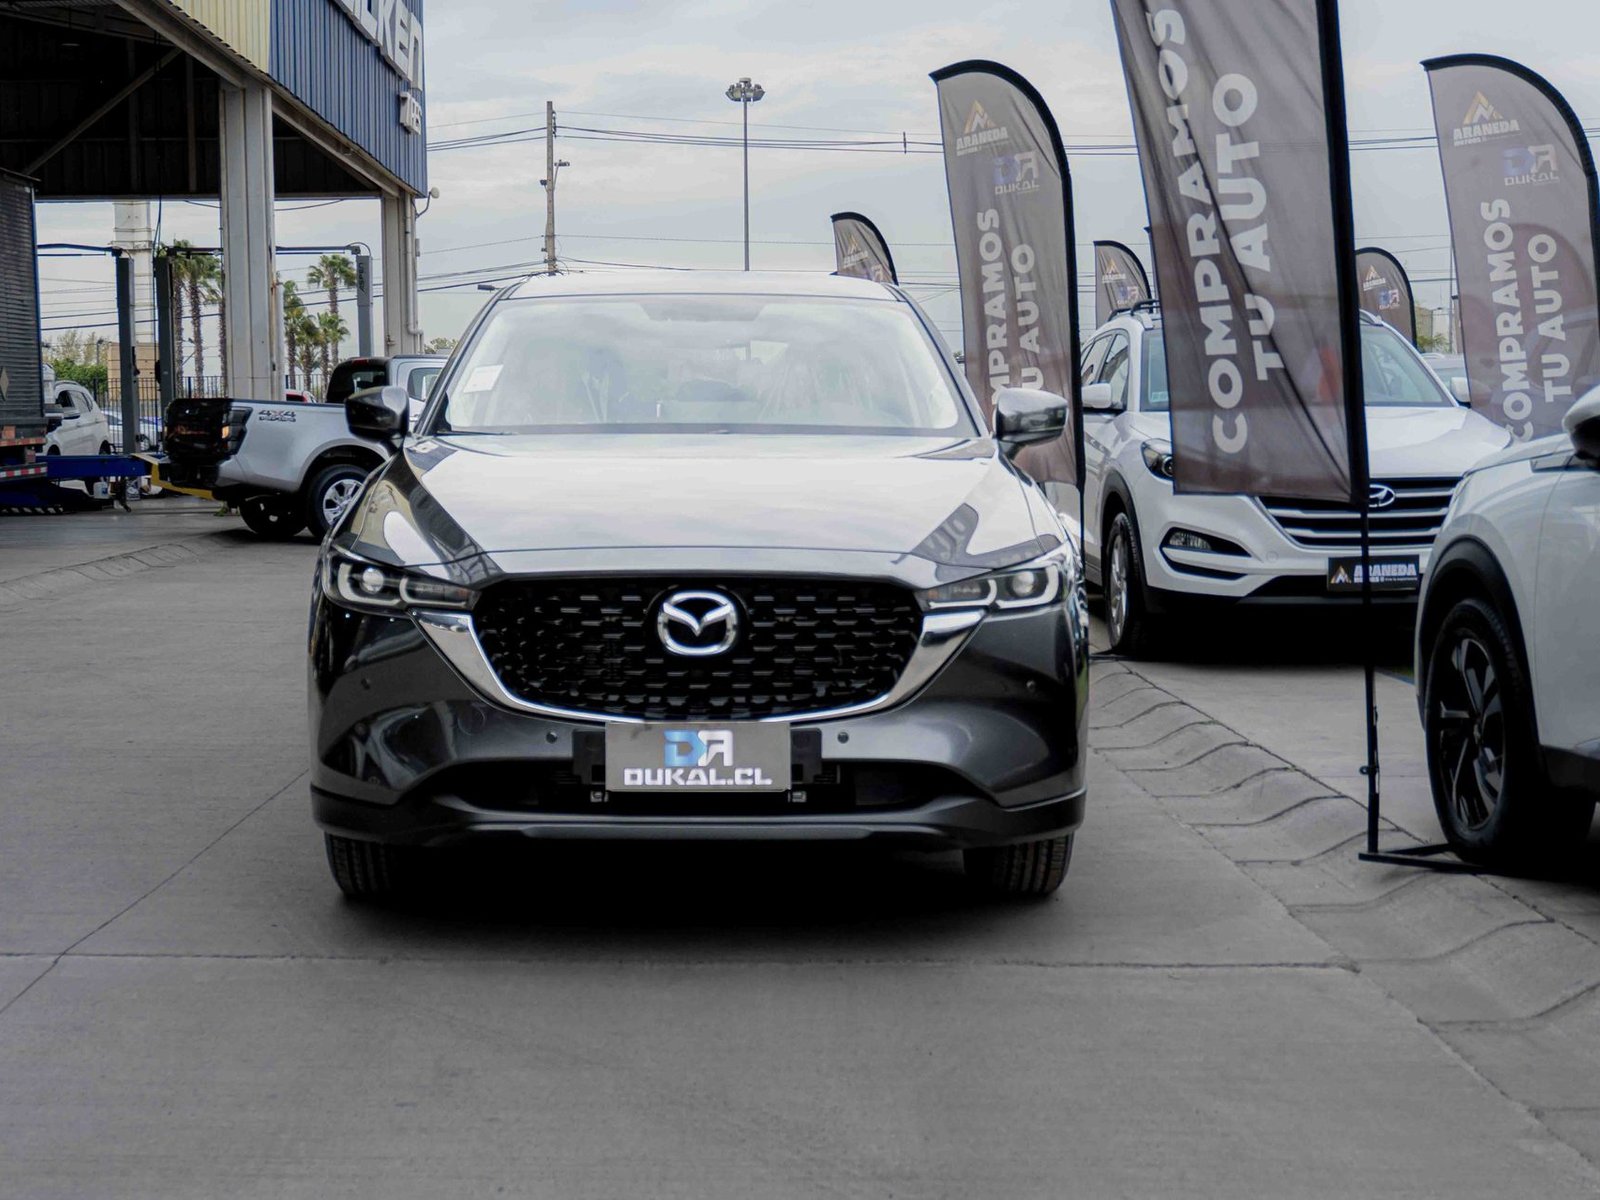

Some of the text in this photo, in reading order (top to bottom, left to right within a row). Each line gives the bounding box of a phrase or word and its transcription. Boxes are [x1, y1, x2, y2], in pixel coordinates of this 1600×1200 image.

[994, 180, 1040, 195] DUKAL
[1453, 119, 1520, 140] ARANEDA
[1504, 172, 1560, 186] DUKAL
[1146, 9, 1249, 454] COMPRAMOS
[1212, 73, 1285, 381] TU AUTO
[977, 208, 1010, 405] MPRAMOS
[1011, 243, 1044, 390] U AUTO
[1480, 199, 1534, 442] COMPRAMOS
[1528, 233, 1572, 403] TU AUTO
[1353, 563, 1417, 578] AANEDA
[624, 768, 773, 786] DUKAL.CL
